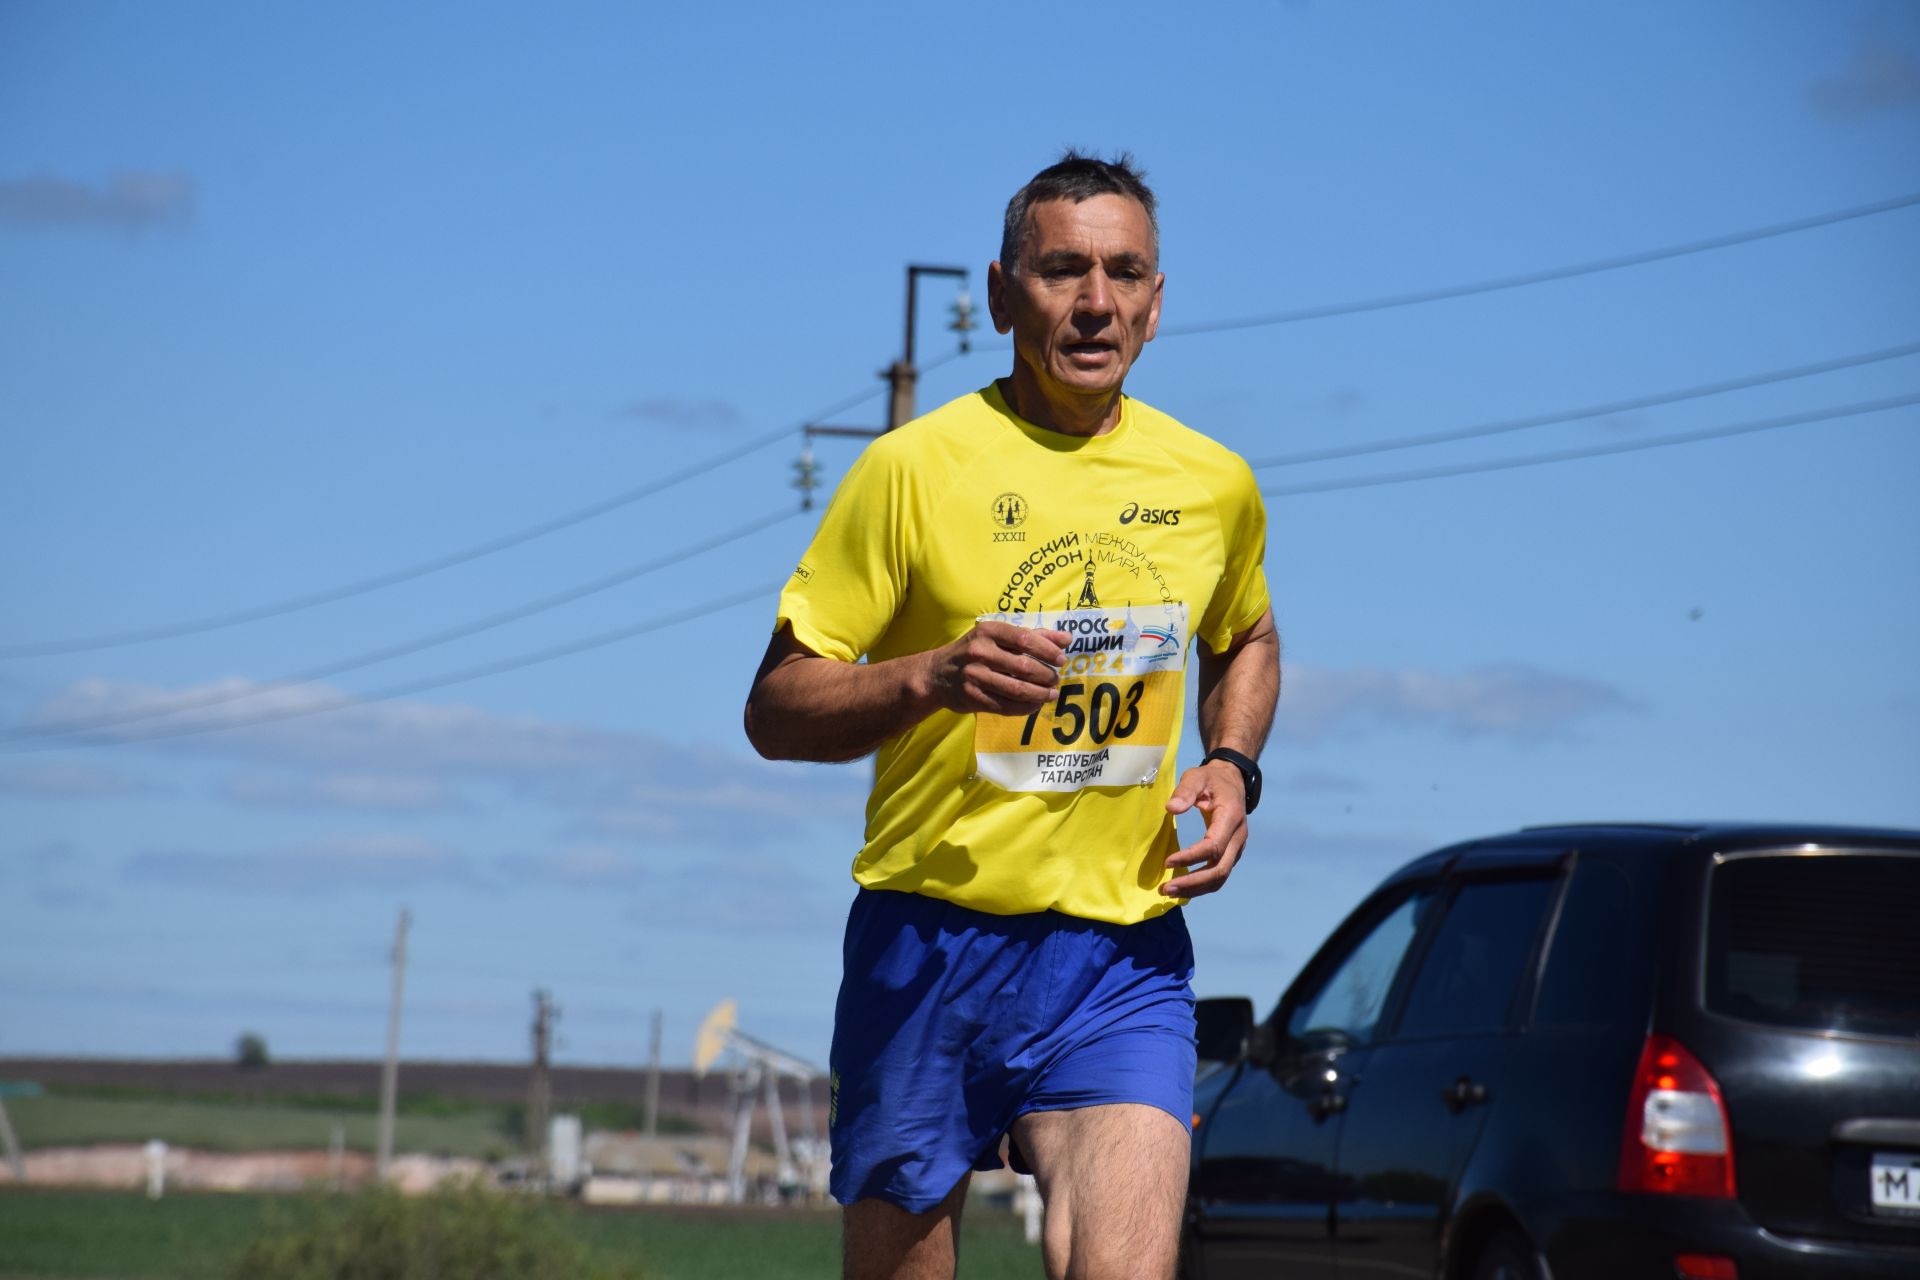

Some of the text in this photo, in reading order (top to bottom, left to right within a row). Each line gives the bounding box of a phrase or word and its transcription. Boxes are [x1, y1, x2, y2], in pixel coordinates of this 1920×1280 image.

[1140, 508, 1181, 526] asics
[993, 531, 1026, 543] XXXII
[1097, 549, 1140, 580] МИРА
[1056, 617, 1109, 635] КРОСС
[1064, 635, 1124, 654] АЦИИ
